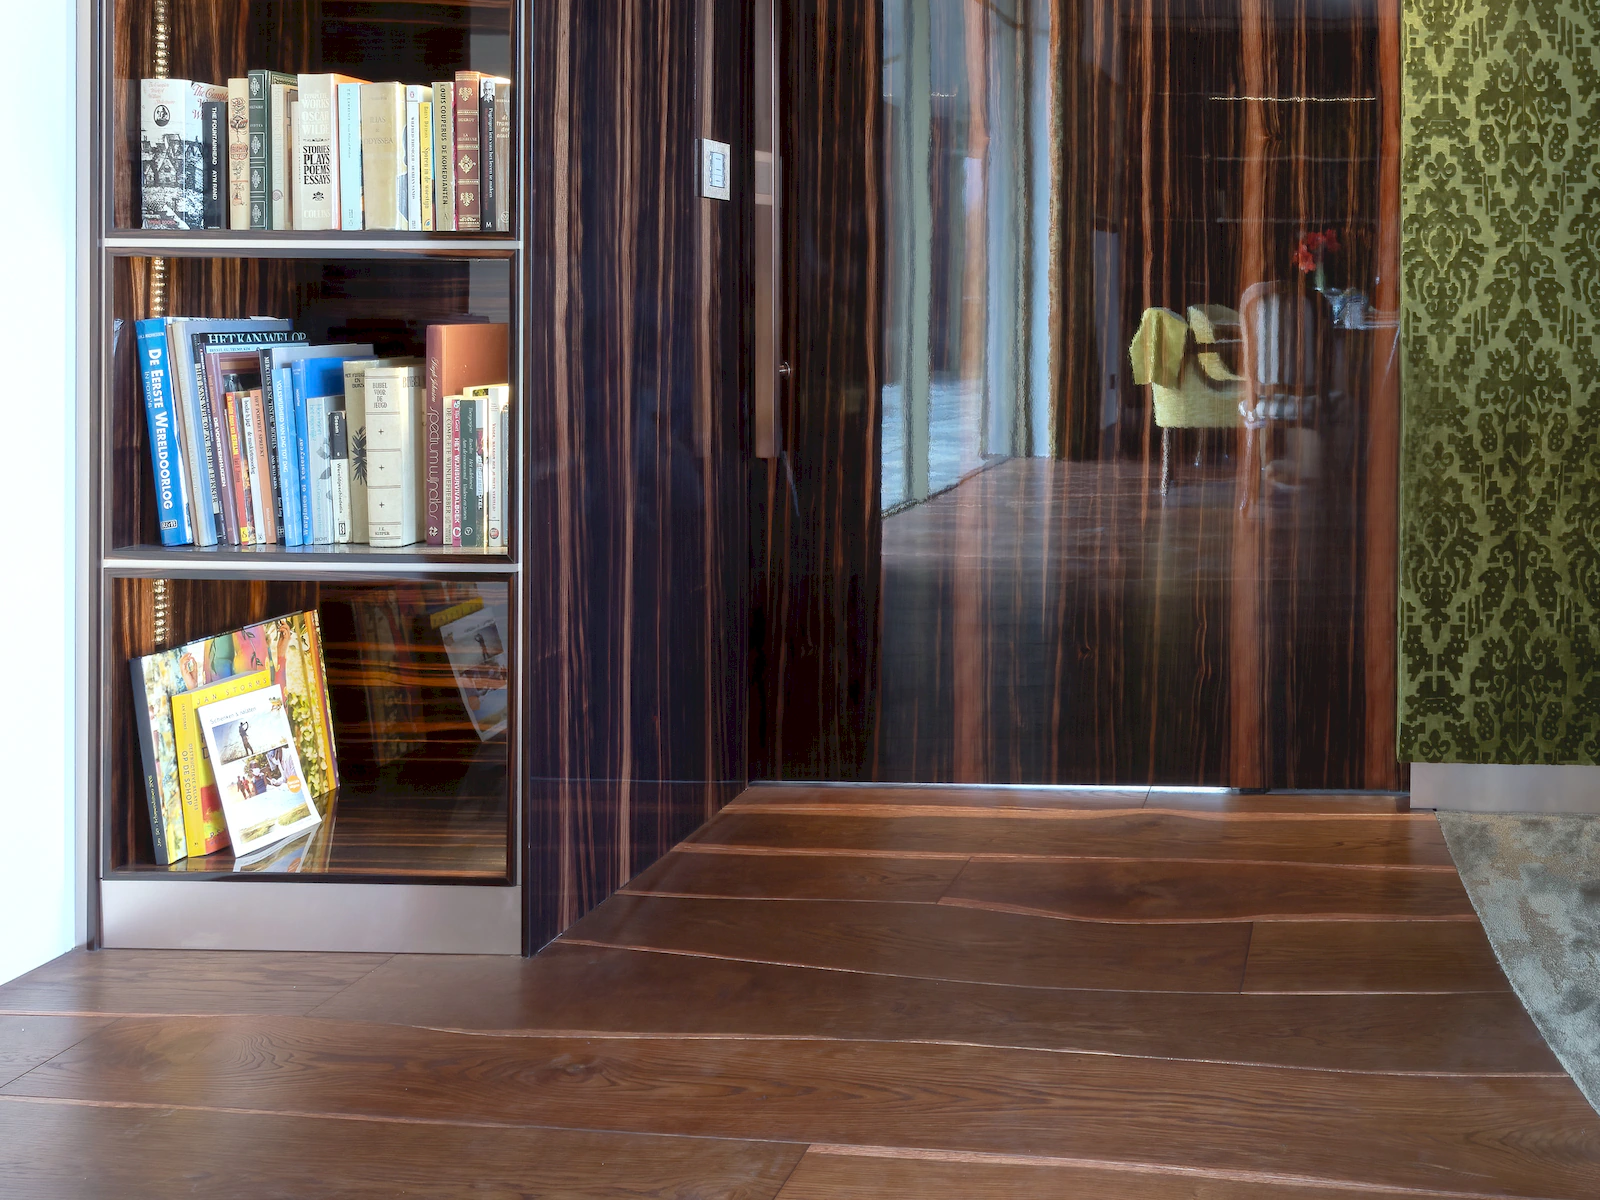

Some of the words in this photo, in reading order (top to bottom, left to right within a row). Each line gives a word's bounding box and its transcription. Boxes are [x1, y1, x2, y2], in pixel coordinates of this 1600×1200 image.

[440, 84, 448, 105] LOUIS
[301, 111, 330, 122] OSCAR
[440, 105, 448, 142] COUPERUS
[302, 124, 331, 135] WILDE
[302, 145, 330, 154] STORIES
[441, 145, 448, 155] DE
[303, 154, 330, 165] PLAYS
[303, 164, 331, 175] POEMS
[303, 174, 331, 185] ESSAYS
[441, 155, 449, 206] KOMEDIANTEN
[147, 349, 162, 366] DE
[150, 369, 164, 409] EERSTE
[372, 382, 389, 390] BIJBEL
[376, 395, 383, 403] DE
[444, 407, 452, 418] DE
[213, 416, 219, 427] DE
[333, 415, 341, 434] Sesam
[444, 418, 452, 455] COMPLETE
[154, 411, 173, 510] WERELDOORLOG
[214, 426, 227, 488] VORSTENHUIZEN
[336, 463, 344, 514] Wereldgeschiedenis
[445, 457, 453, 515] WIJNLIEFHEBBER
[195, 692, 218, 707] JAN
[225, 676, 268, 697] STORMS
[181, 749, 189, 762] OP
[182, 762, 190, 778] DE
[184, 778, 193, 807] SCHOP
